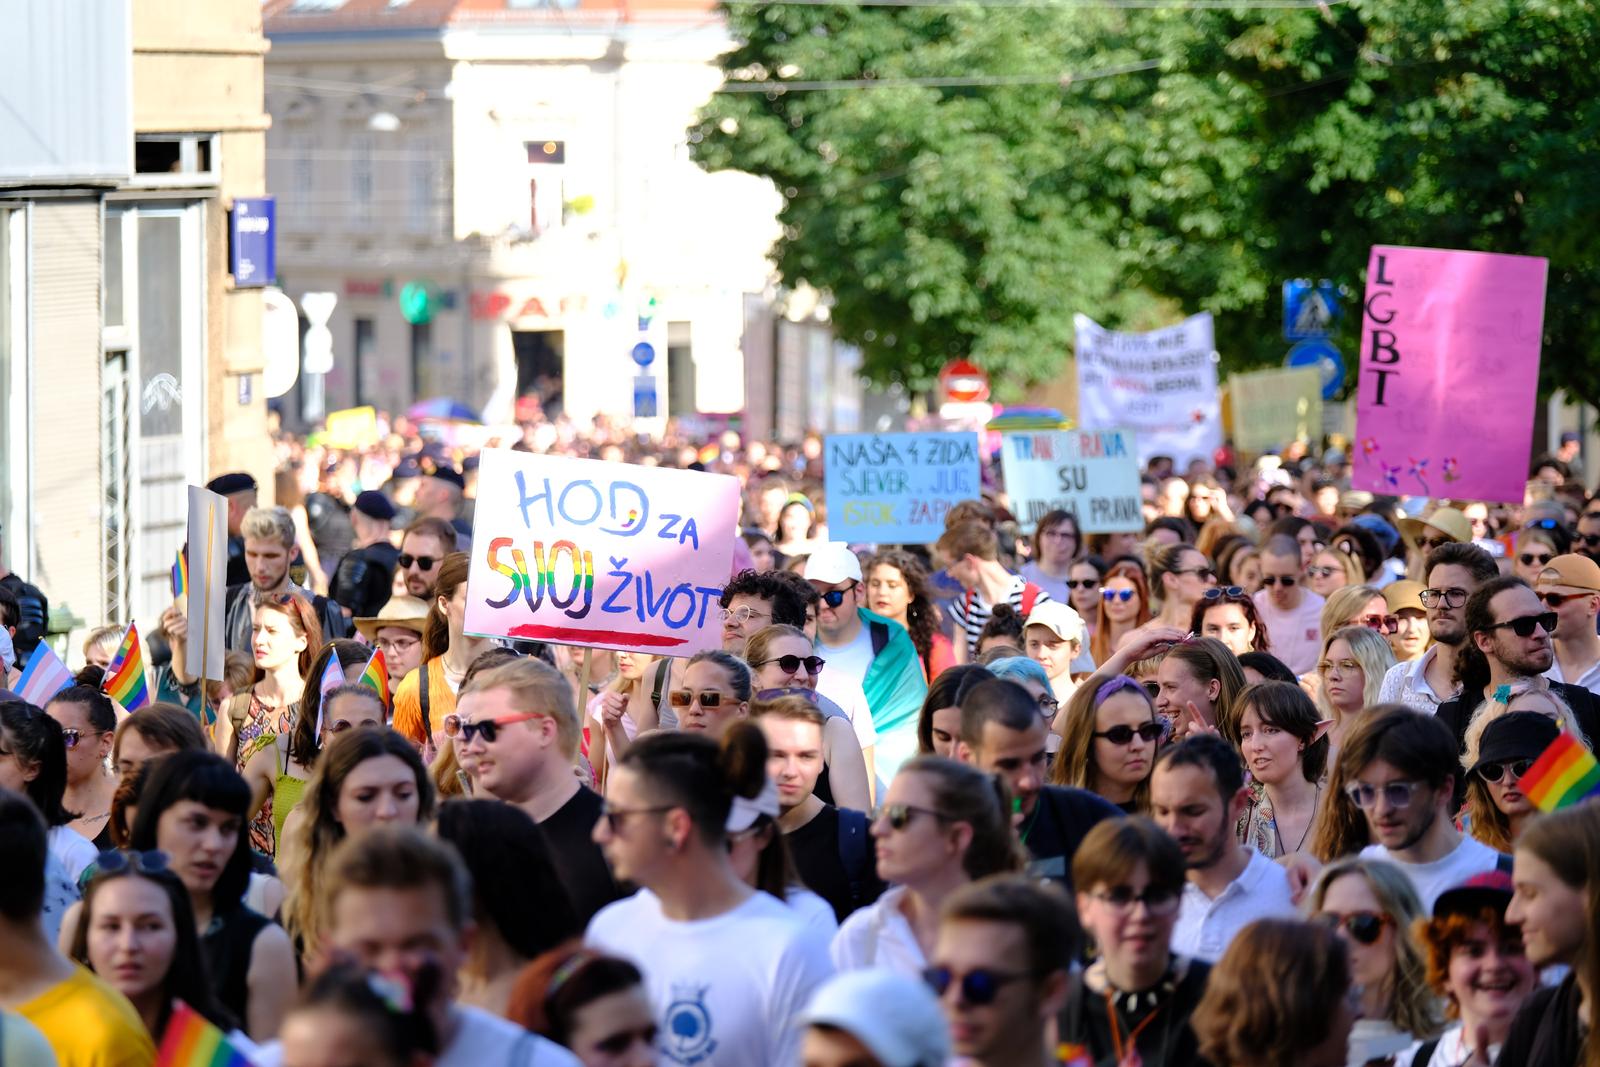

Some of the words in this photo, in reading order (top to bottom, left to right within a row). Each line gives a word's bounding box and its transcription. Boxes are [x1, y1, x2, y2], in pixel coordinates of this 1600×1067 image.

[1365, 254, 1400, 407] LGBT
[831, 434, 904, 467] NAŠA
[926, 437, 976, 466] ZIDA
[1058, 464, 1088, 493] SU
[514, 470, 650, 537] HOD
[657, 513, 699, 550] ZA
[1090, 496, 1141, 524] PRAVA
[485, 537, 594, 619] SVOJ
[600, 555, 722, 630] ŽIVOT
